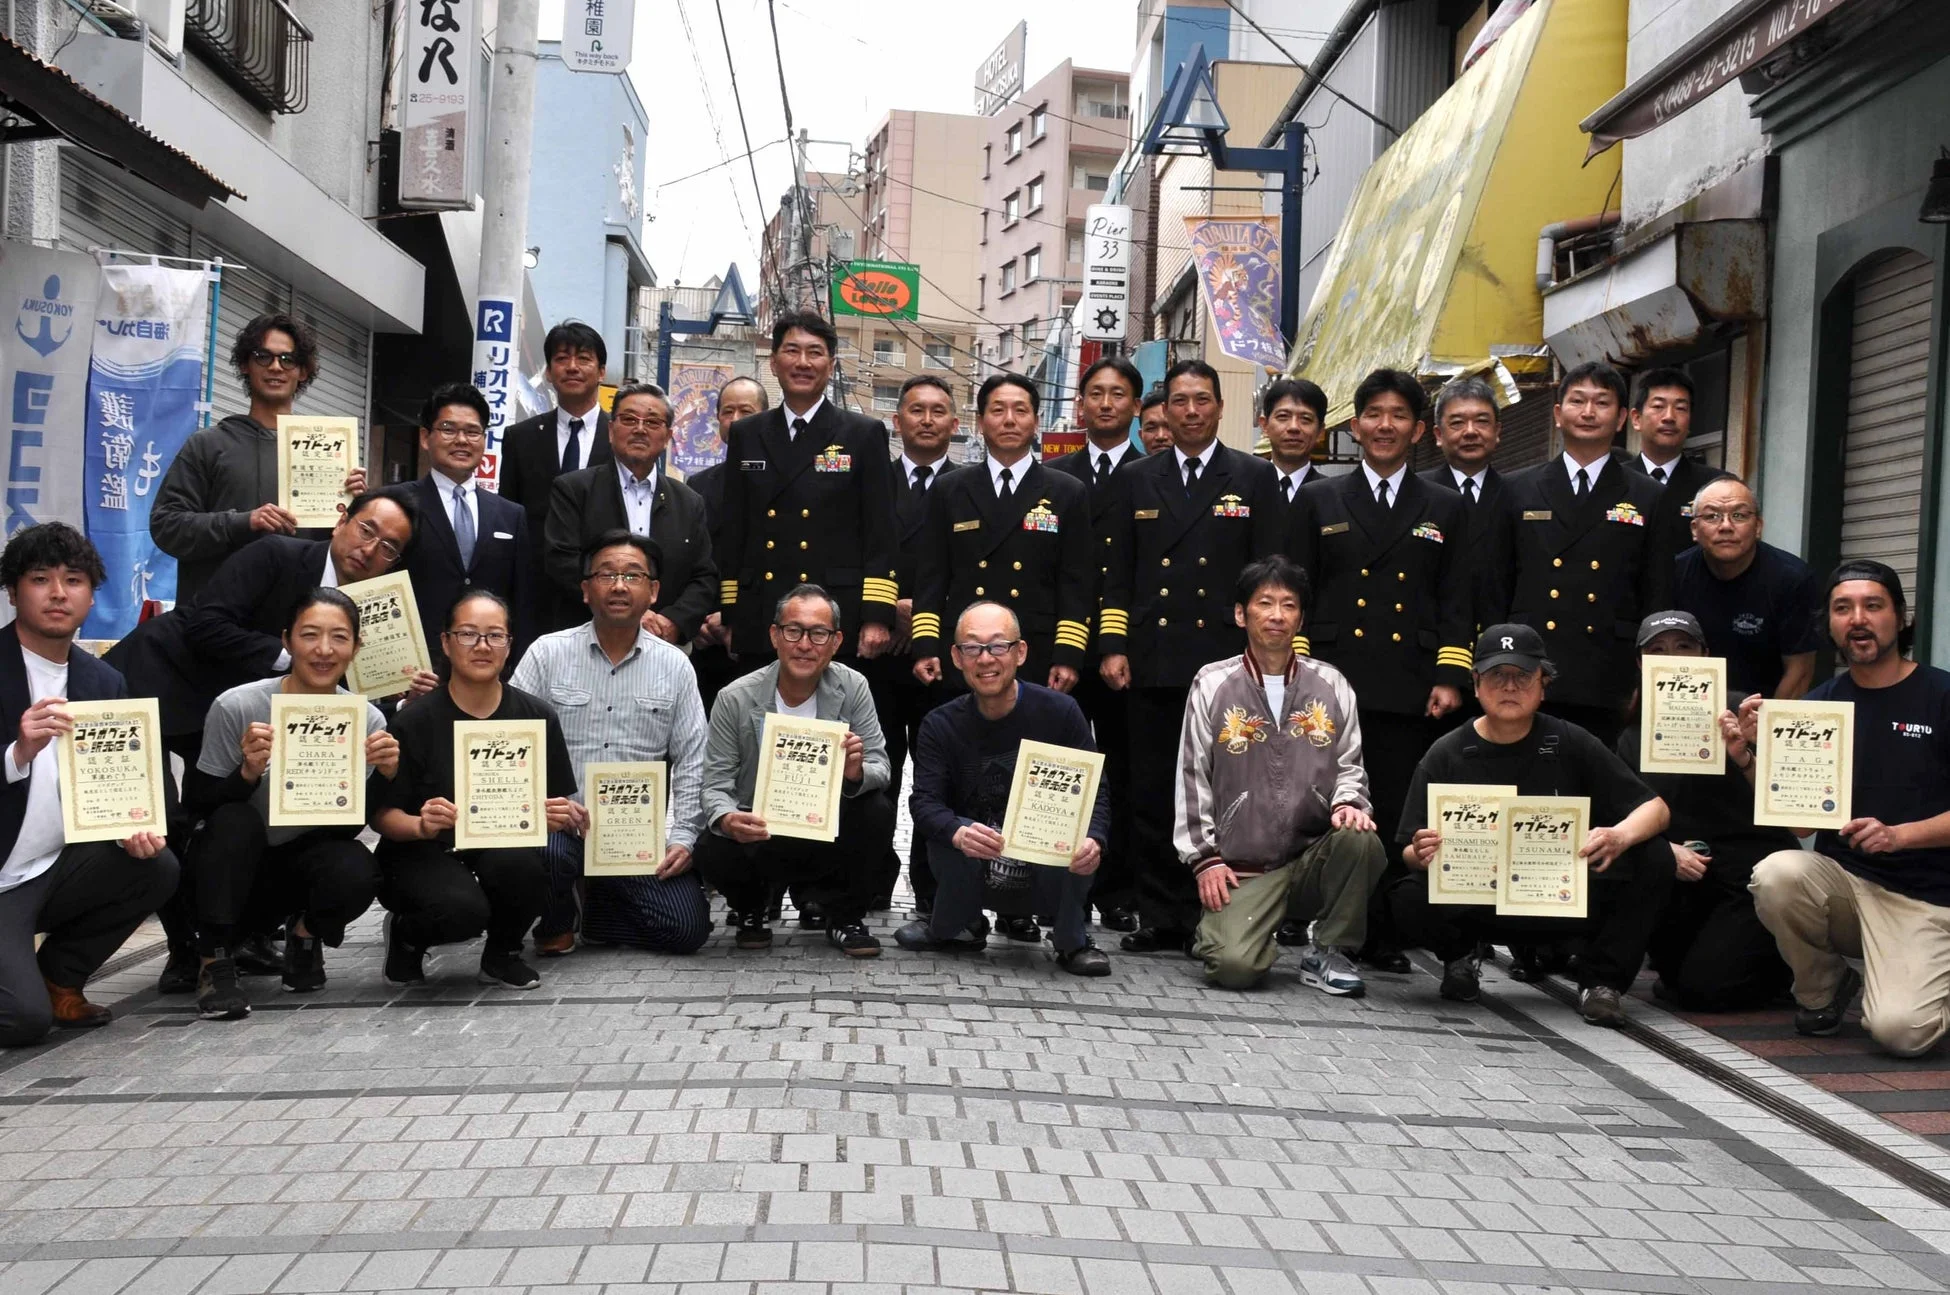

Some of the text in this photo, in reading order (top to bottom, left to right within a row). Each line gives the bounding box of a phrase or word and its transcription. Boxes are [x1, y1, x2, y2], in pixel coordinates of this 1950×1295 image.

[984, 43, 1008, 86] HOTEL
[419, 93, 464, 104] 25-9193
[1092, 217, 1127, 237] Pier
[1099, 241, 1119, 259] 33
[486, 345, 509, 450] リオネット
[1043, 444, 1060, 454] NEW
[1501, 636, 1514, 650] R
[80, 766, 137, 774] YOKOSUKA
[1031, 803, 1067, 815] KADOYA
